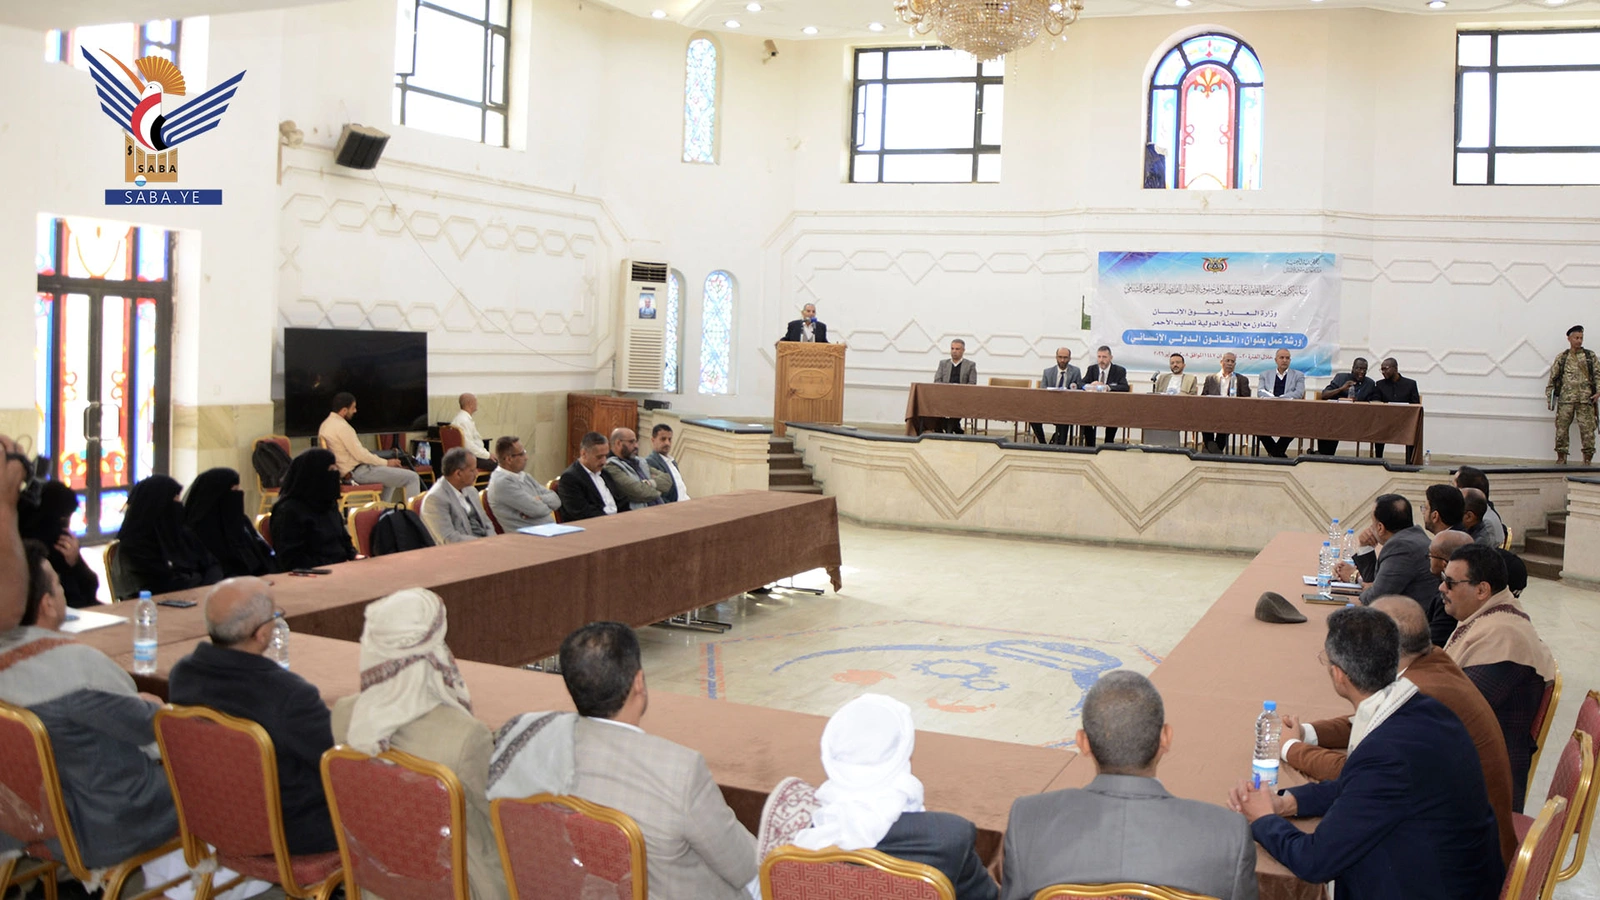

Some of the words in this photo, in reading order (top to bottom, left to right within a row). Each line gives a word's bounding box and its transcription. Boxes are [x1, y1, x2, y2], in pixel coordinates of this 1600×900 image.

[1260, 309, 1277, 318] وزارة
[1174, 320, 1196, 328] للصليب
[1198, 319, 1221, 328] الدولية
[1222, 320, 1242, 329] اللجنة
[1242, 322, 1251, 330] مع
[1251, 321, 1277, 329] بالتعاون
[1168, 334, 1202, 345] الدولي
[1267, 336, 1283, 346] عمل
[1284, 336, 1302, 347] ورشة
